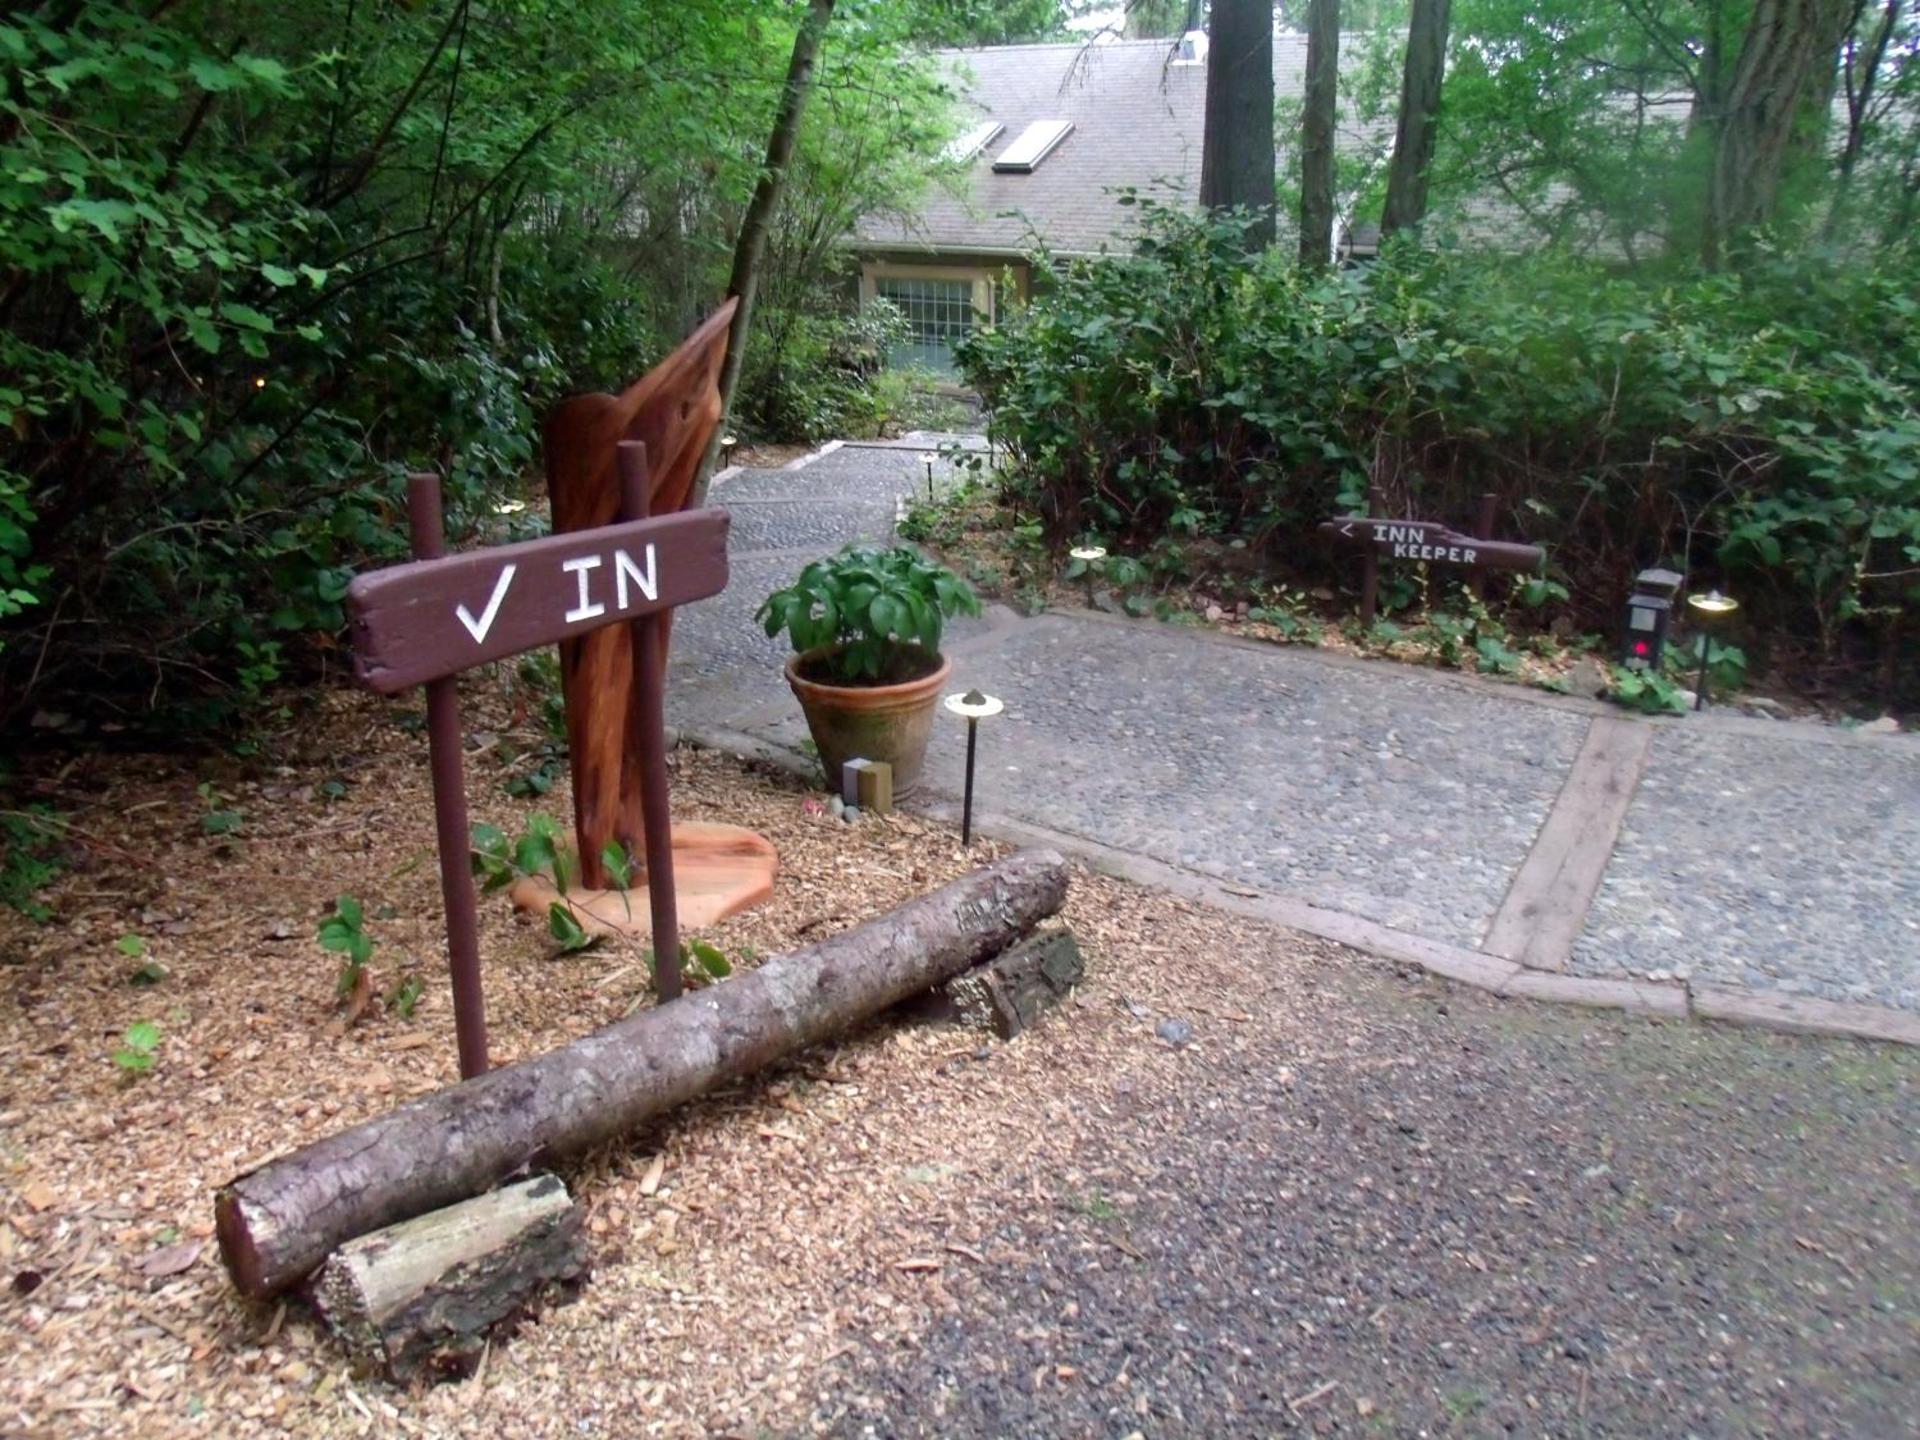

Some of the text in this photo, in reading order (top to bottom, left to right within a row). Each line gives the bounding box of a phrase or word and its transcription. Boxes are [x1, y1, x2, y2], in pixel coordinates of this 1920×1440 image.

[1373, 525, 1424, 543] INN
[1394, 544, 1477, 563] KEEPER
[563, 543, 658, 623] IN
